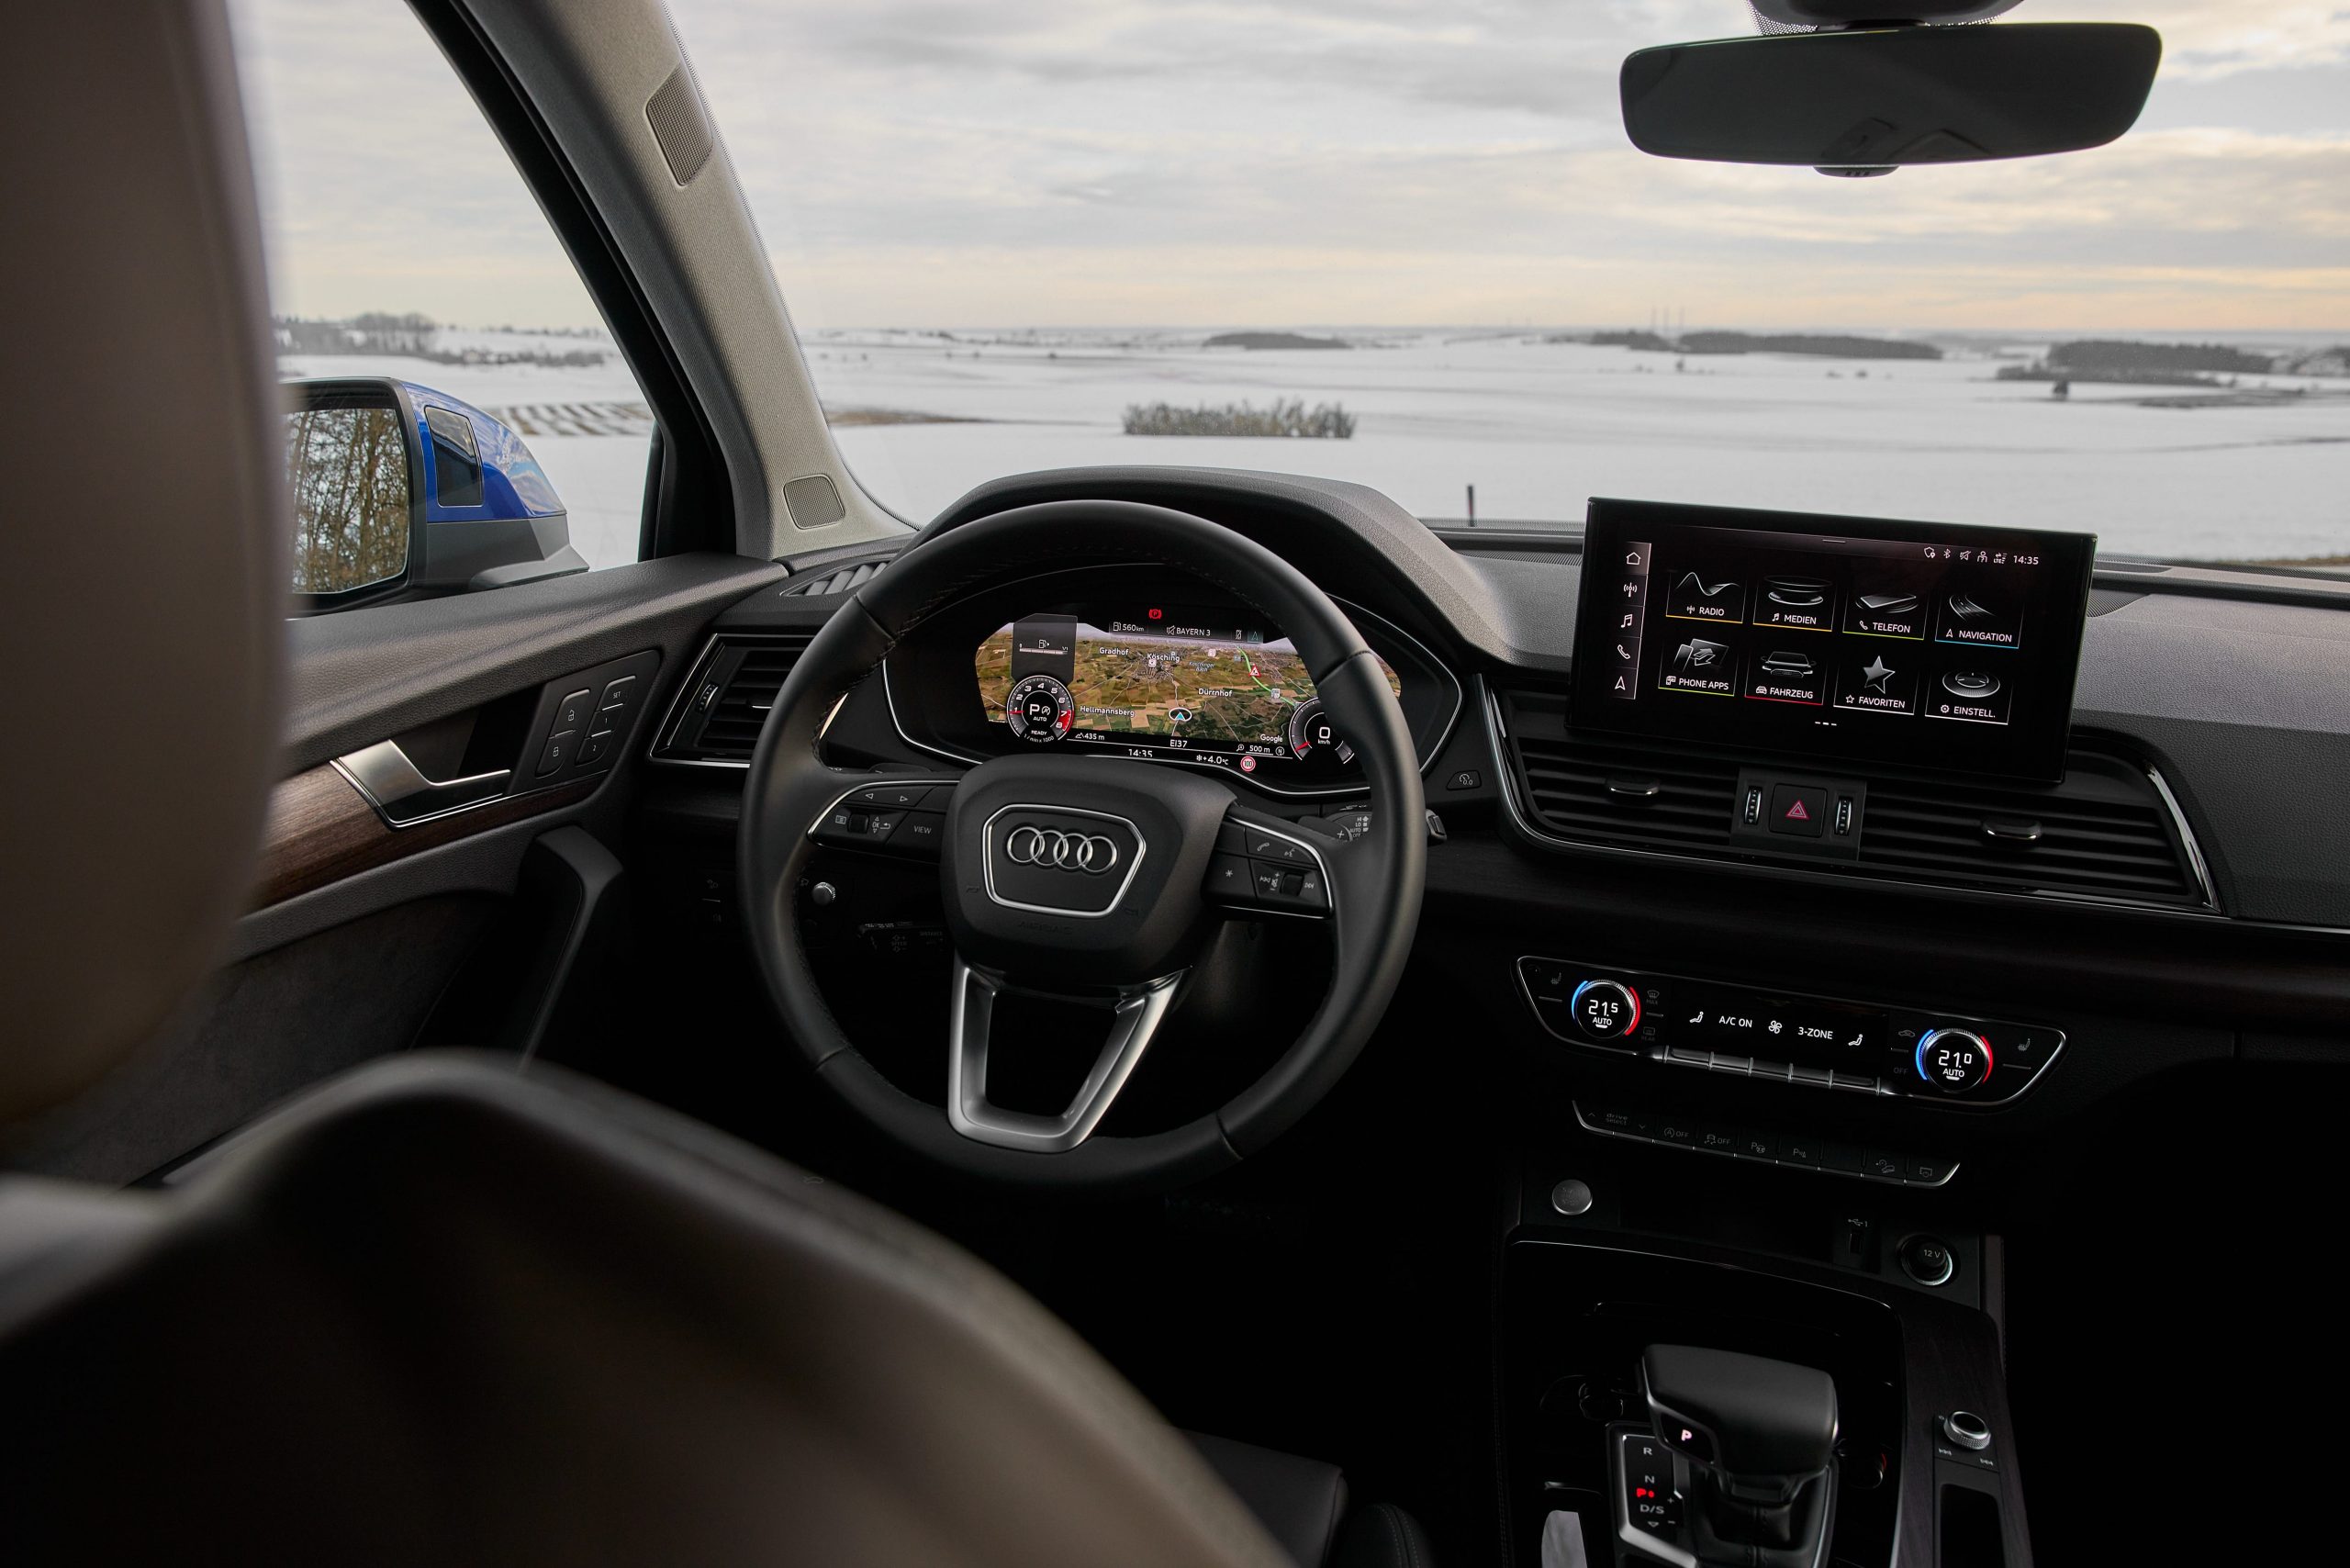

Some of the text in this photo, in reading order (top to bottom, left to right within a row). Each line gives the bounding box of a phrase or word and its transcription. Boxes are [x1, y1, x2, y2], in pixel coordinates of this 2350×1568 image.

[2013, 554, 2039, 566] 14:35
[1698, 607, 1725, 617] RADIO
[1784, 614, 1817, 625] MEDIEN
[1176, 627, 1205, 636] BAYERN
[1872, 622, 1911, 633] TELEFON
[1958, 630, 2013, 643] NAVIGATION
[1099, 647, 1129, 655] Gradhof
[1147, 653, 1181, 664] Kösching
[1678, 678, 1729, 690] PHONE APPS
[612, 691, 621, 700] SET
[1769, 687, 1814, 700] FAHRZEUG
[1858, 696, 1906, 709] FAVORITEN
[1029, 703, 1040, 716] P
[1060, 710, 1068, 718] 7
[1080, 705, 1135, 718] Hellmannsberg
[1953, 706, 1996, 719] EINSTELL.
[1056, 721, 1063, 729] 8
[1084, 733, 1097, 741] 435
[1318, 726, 1331, 740] 0
[1259, 734, 1283, 744] Google
[1128, 748, 1153, 757] 14:35
[913, 825, 932, 834] VIEW
[1592, 1016, 1613, 1026] AUTO
[1718, 1014, 1753, 1028] A/C ON
[1797, 1026, 1834, 1040] 3-ZONE
[1893, 1067, 1909, 1075] OFF
[1942, 1068, 1965, 1078] AUTO
[1675, 1130, 1690, 1138] OFF
[1717, 1137, 1731, 1146] OFF
[1923, 1249, 1941, 1260] 12 V
[1681, 1428, 1693, 1442] P
[1642, 1447, 1653, 1456] R
[1644, 1474, 1655, 1484] N
[1639, 1503, 1665, 1516] D/S
